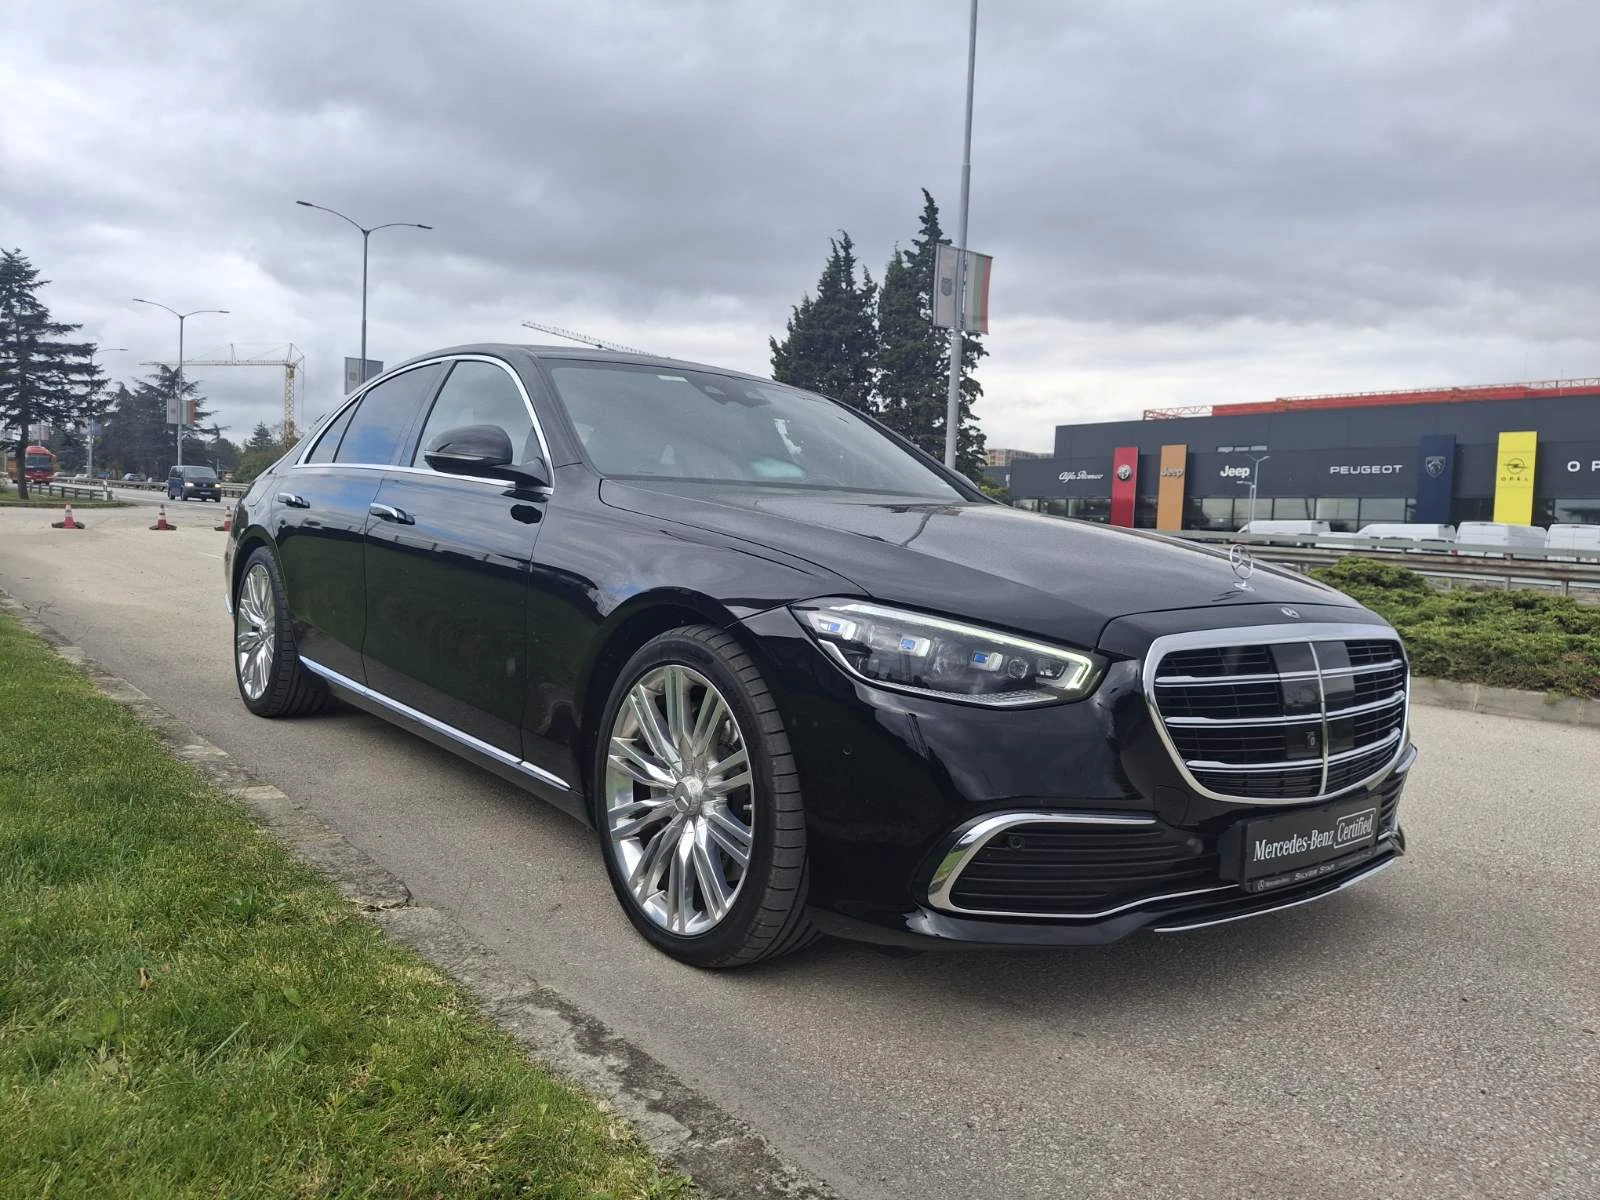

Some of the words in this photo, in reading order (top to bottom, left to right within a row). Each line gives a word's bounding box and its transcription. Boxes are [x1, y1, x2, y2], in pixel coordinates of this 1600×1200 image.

[1160, 466, 1184, 478] Jeep
[1220, 465, 1250, 479] Jeep
[1329, 464, 1404, 474] PEUGEOT
[1058, 471, 1077, 484] Alfa
[1076, 470, 1104, 480] Romeo
[1253, 829, 1335, 862] Mercedes-Benz
[1337, 813, 1374, 842] Certified
